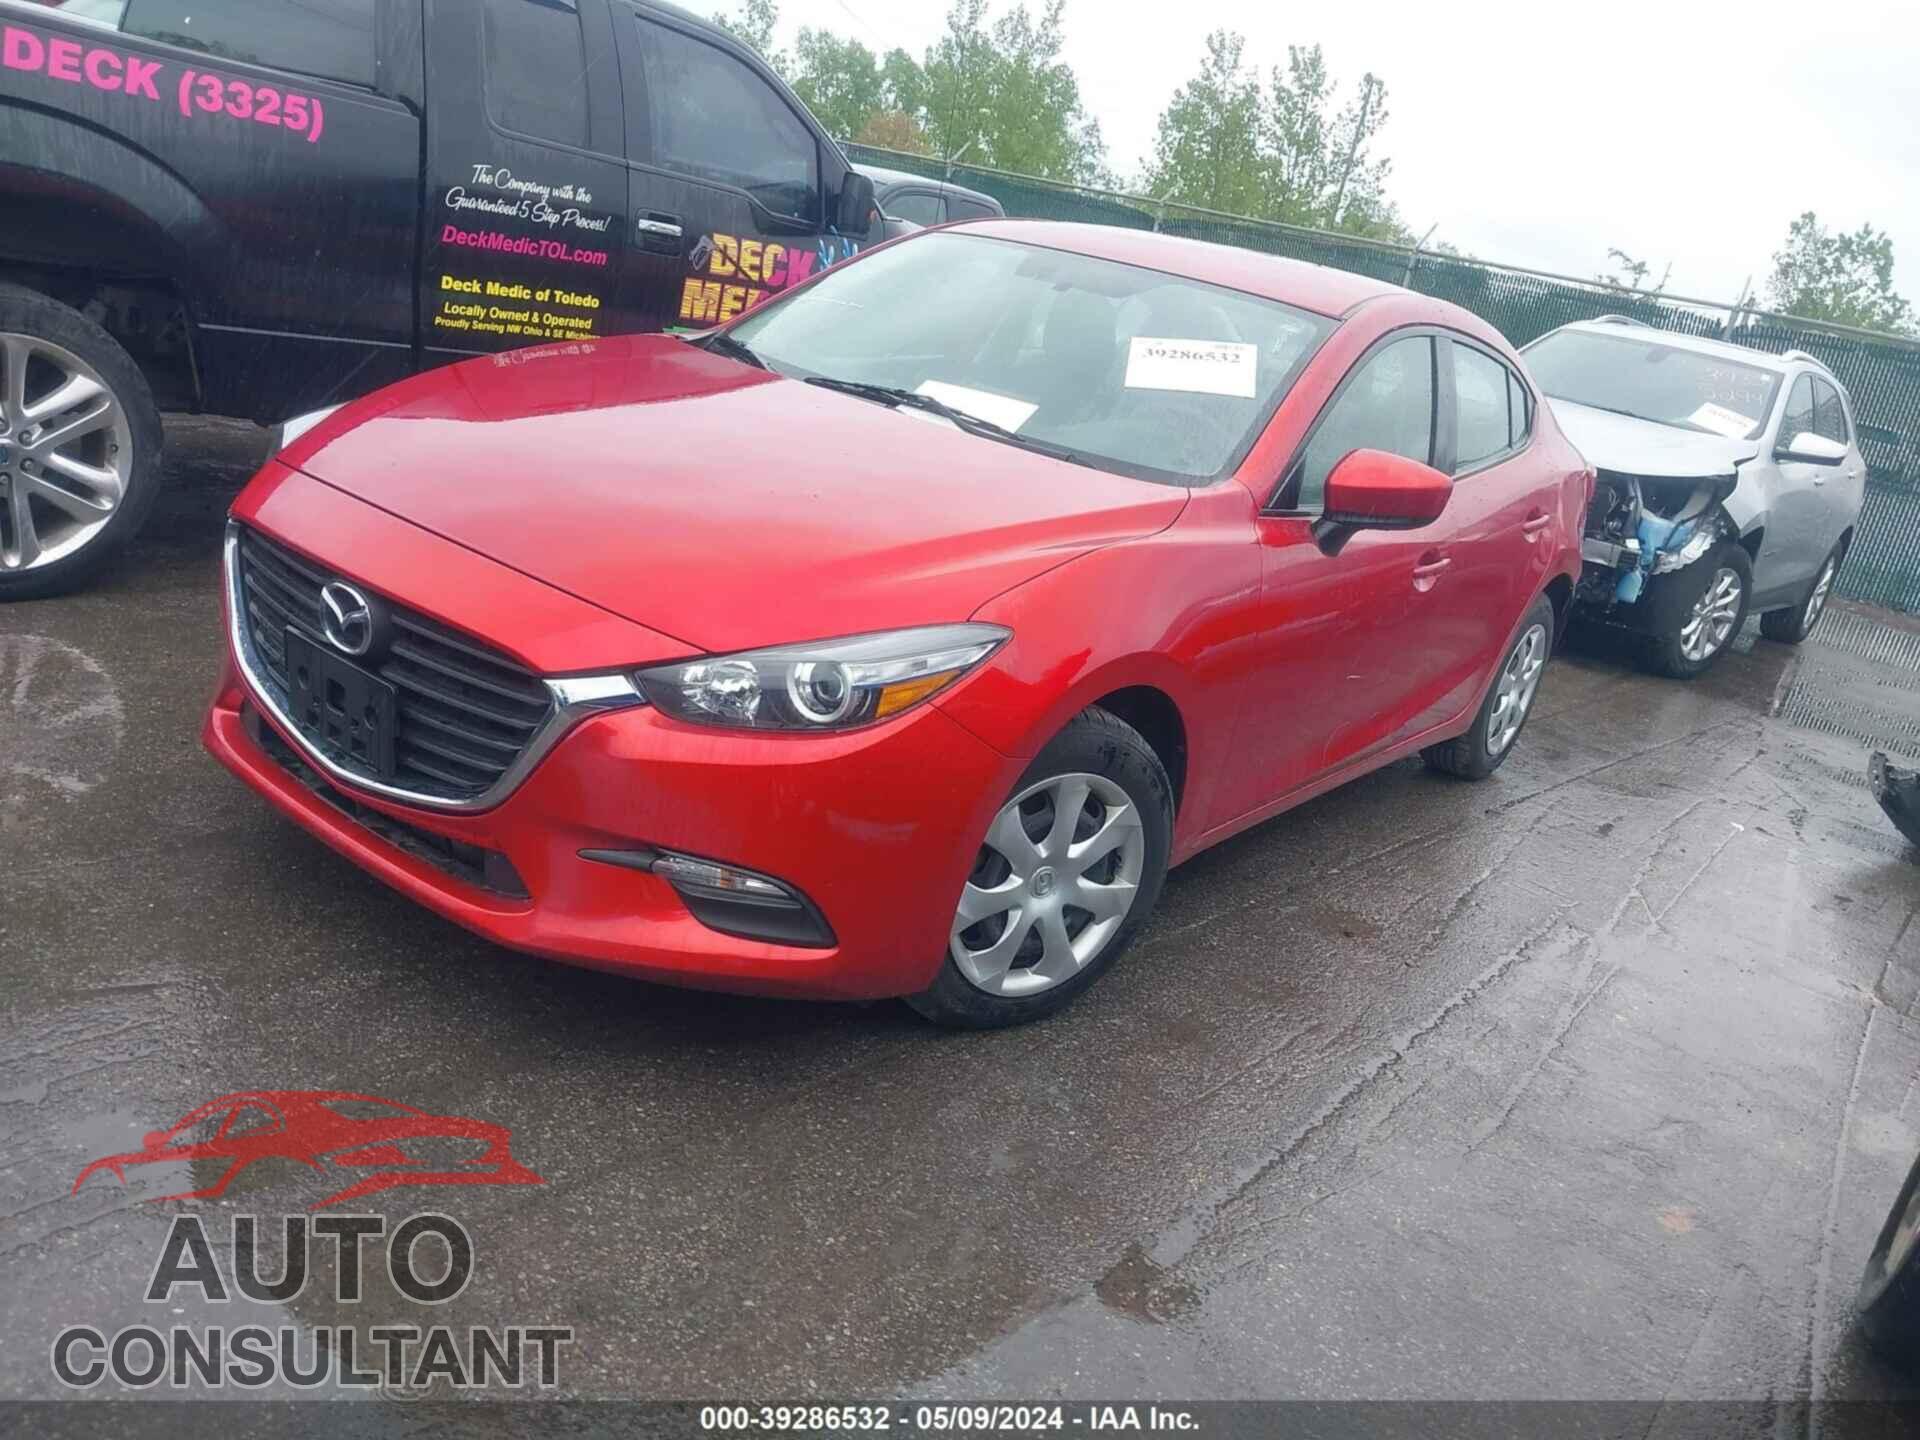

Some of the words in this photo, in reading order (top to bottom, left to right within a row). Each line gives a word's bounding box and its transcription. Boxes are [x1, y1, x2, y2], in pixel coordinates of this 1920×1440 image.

[2, 27, 163, 100] DECK
[178, 70, 325, 143] (3325)
[471, 164, 494, 184] The
[494, 168, 551, 203] Company
[552, 184, 574, 200] with
[575, 186, 593, 203] the
[445, 186, 520, 216] Guaranteed
[519, 200, 531, 218] 5
[530, 202, 560, 228] Step
[561, 208, 612, 232] Process!
[442, 225, 608, 266] DeckMedicTOL.com
[709, 232, 817, 288] DECK
[441, 275, 482, 294] Deck
[486, 281, 532, 300] Medic
[535, 288, 550, 303] of
[554, 290, 600, 308] Toledo
[434, 316, 470, 331] Proudly
[472, 320, 505, 334] Serving
[507, 323, 521, 334] NW
[523, 326, 543, 337] Ohio
[444, 302, 487, 319] Locally
[489, 307, 530, 323] Owned
[531, 312, 540, 323] &
[543, 313, 593, 329] Operated
[1142, 347, 1241, 364] 39286532
